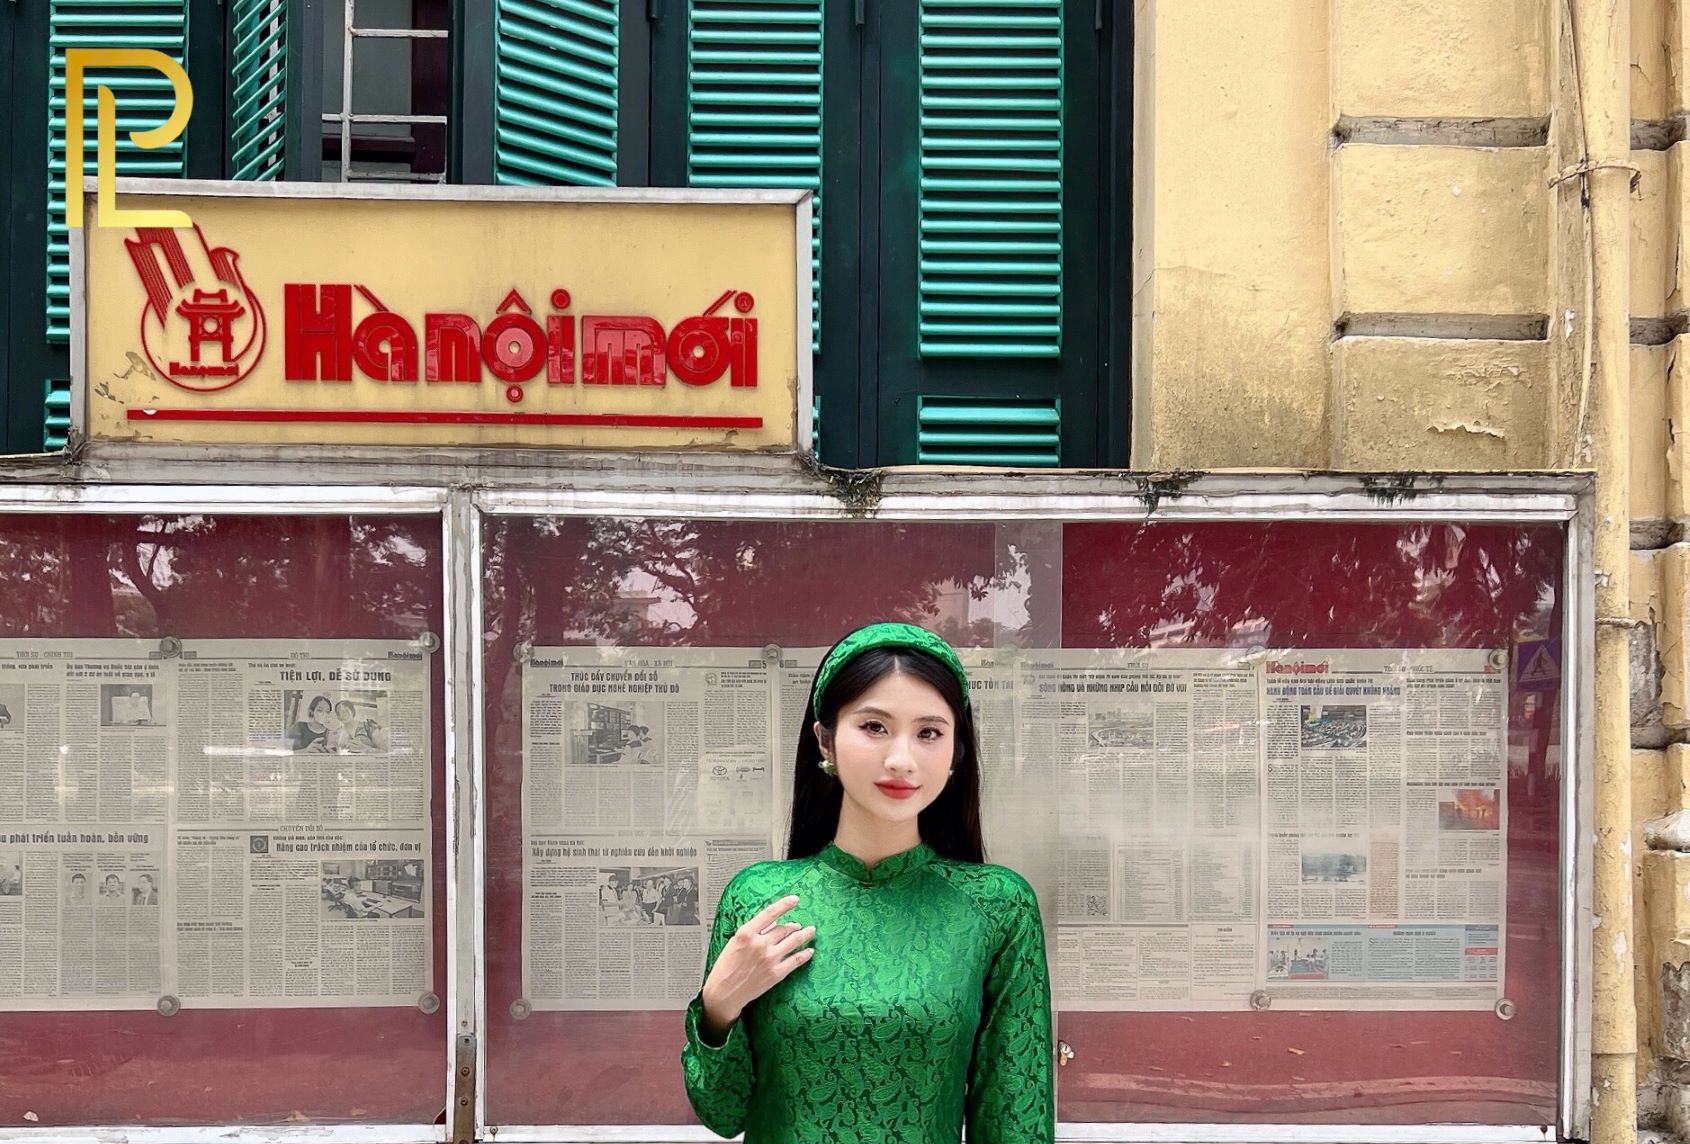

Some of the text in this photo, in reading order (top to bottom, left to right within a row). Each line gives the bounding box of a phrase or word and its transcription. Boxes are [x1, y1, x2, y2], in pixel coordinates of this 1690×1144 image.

[762, 660, 767, 669] 5
[280, 669, 302, 683] TIỆN
[329, 668, 342, 681] DỄ
[345, 669, 360, 681] SỬ
[10, 832, 29, 844] phát
[32, 831, 54, 843] triển
